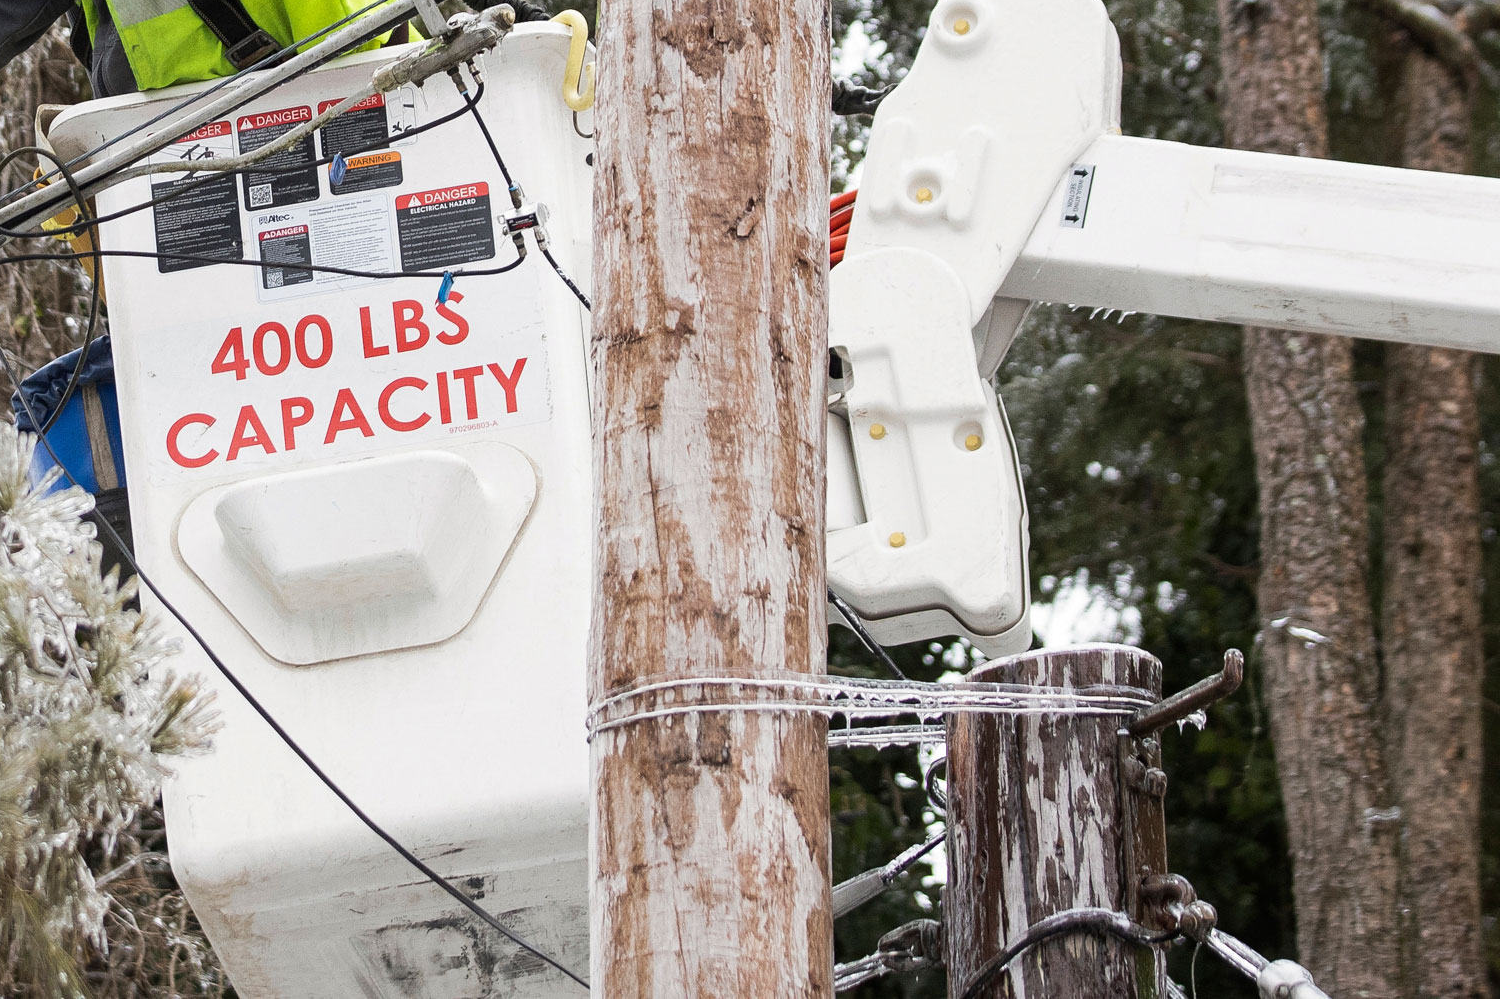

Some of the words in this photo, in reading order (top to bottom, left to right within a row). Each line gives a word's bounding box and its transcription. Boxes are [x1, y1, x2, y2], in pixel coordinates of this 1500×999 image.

[256, 108, 309, 126] DANGER
[348, 154, 392, 168] WARNING
[424, 186, 478, 204] DANGER
[1067, 183, 1077, 207] SECTION
[1073, 179, 1084, 212] INSULATING
[410, 203, 448, 215] ELECTRICAL
[449, 198, 477, 208] HAZARD
[268, 214, 290, 223] Altec
[270, 225, 305, 238] DANGER
[211, 314, 333, 381] 400
[359, 290, 470, 360] LBS
[166, 357, 528, 469] CAPACITY
